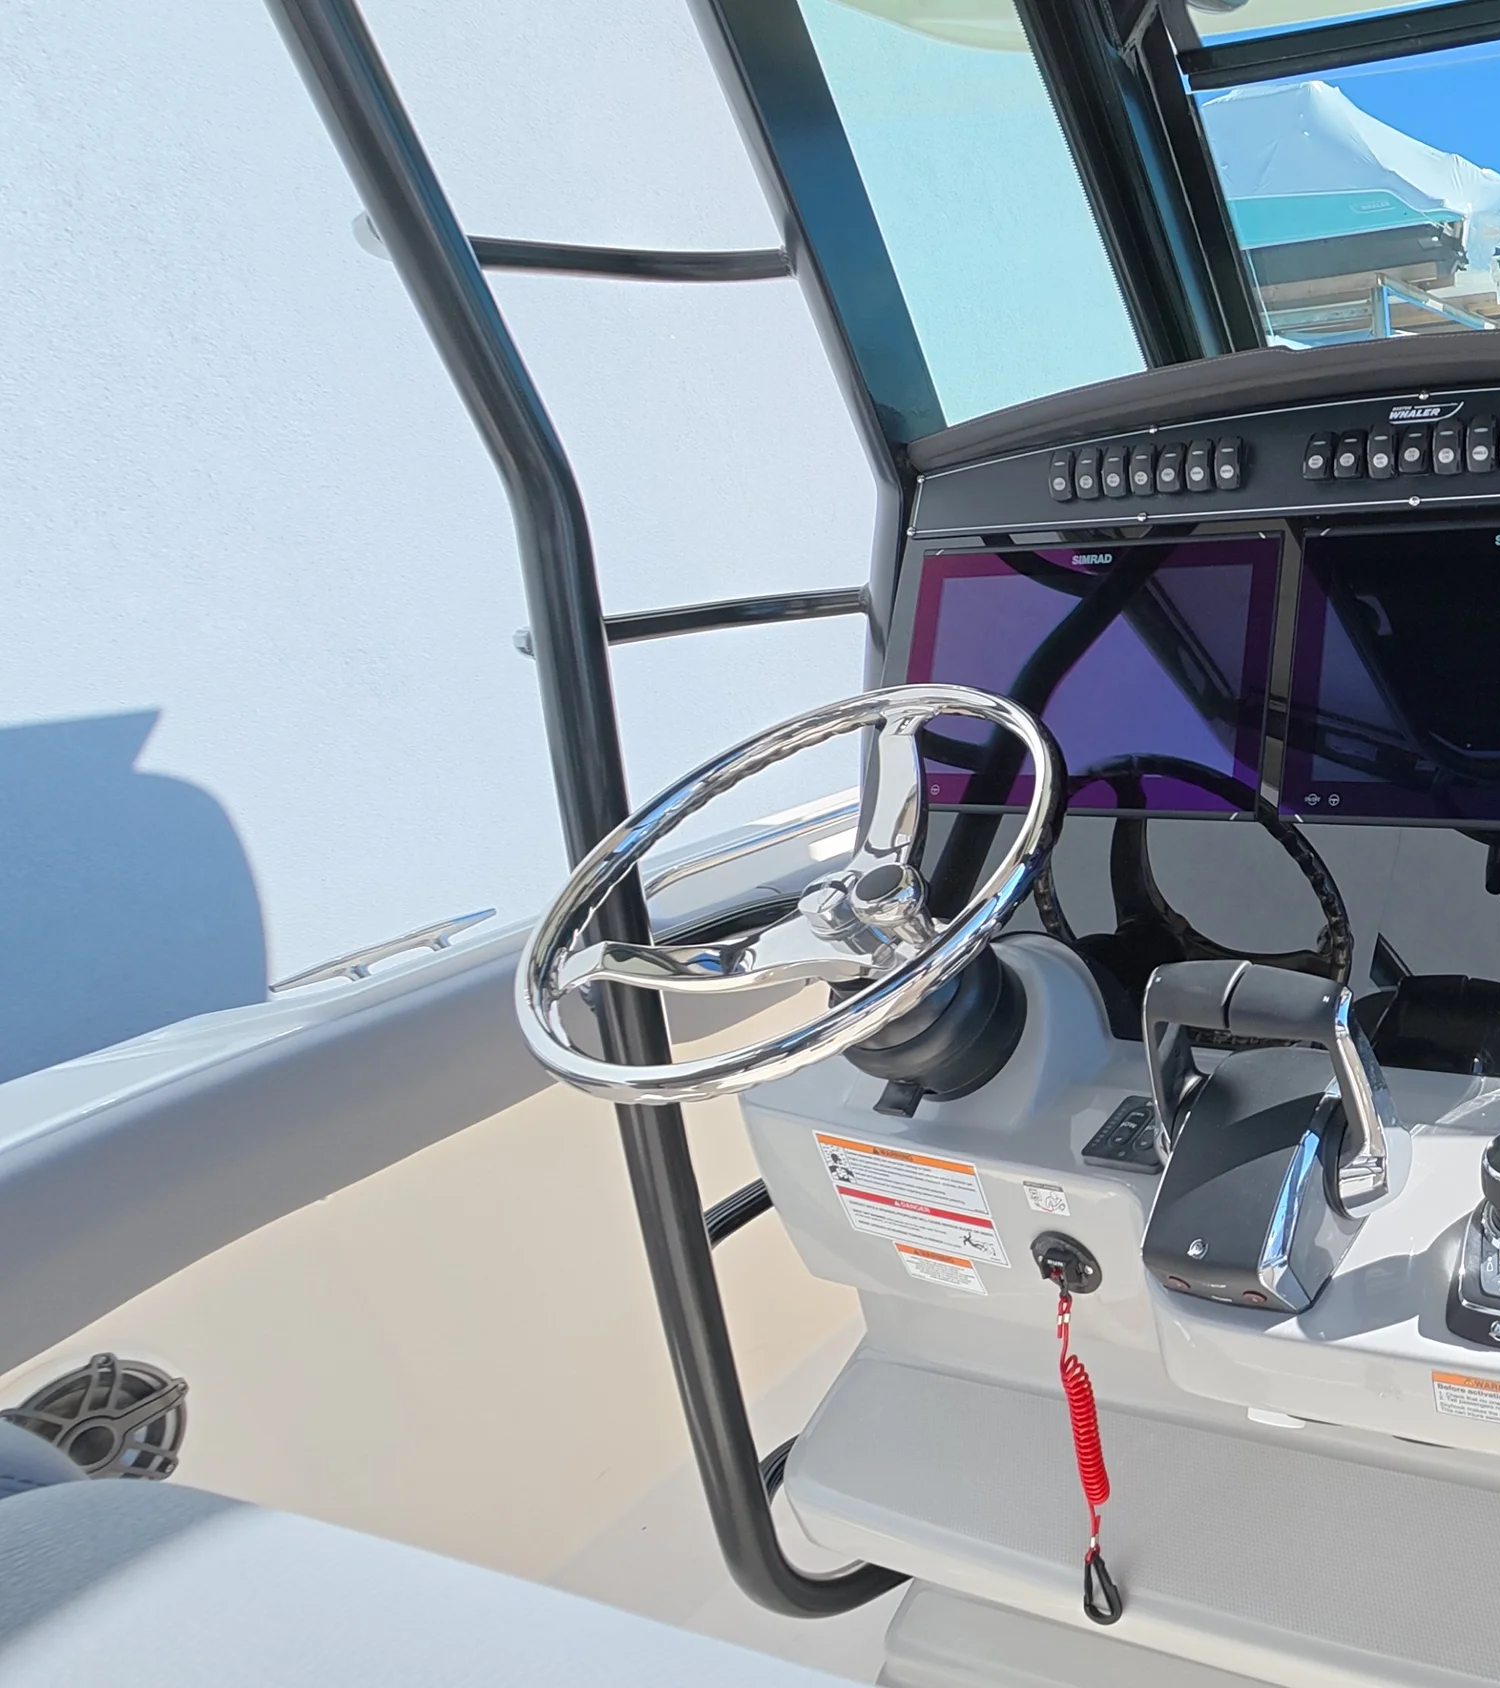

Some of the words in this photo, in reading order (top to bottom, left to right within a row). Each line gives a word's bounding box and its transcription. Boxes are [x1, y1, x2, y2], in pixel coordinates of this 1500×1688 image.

[1389, 408, 1441, 420] WHALER
[1071, 553, 1113, 565] SIMRAD
[899, 1200, 931, 1214] DANGER
[1437, 1383, 1465, 1393] Before
